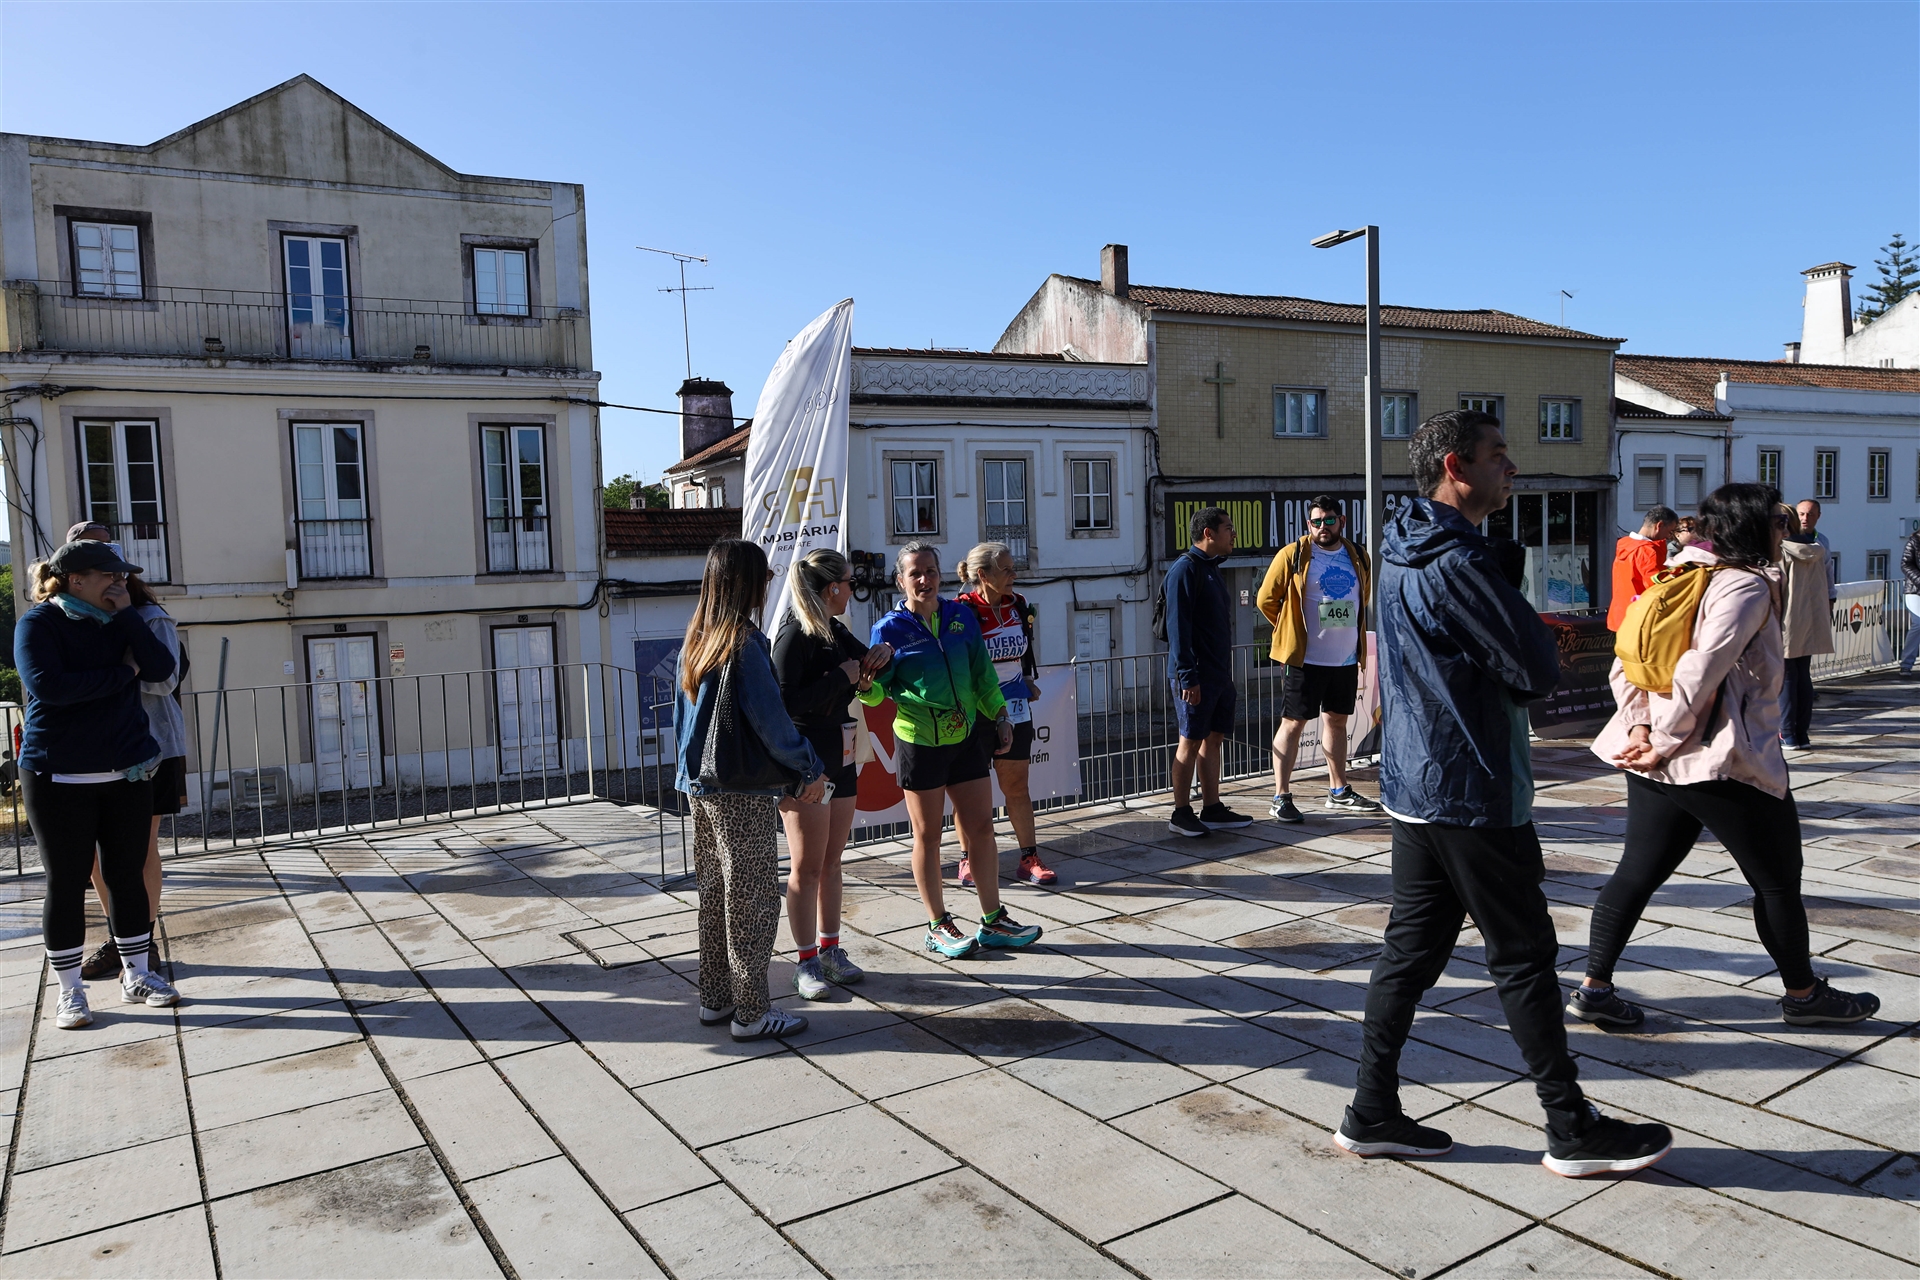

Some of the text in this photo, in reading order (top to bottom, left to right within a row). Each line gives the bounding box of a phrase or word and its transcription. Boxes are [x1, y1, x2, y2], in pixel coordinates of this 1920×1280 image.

[1328, 607, 1350, 619] 464
[1831, 608, 1849, 633] MIA
[987, 634, 1027, 650] LVERCA
[1011, 700, 1024, 713] 75
